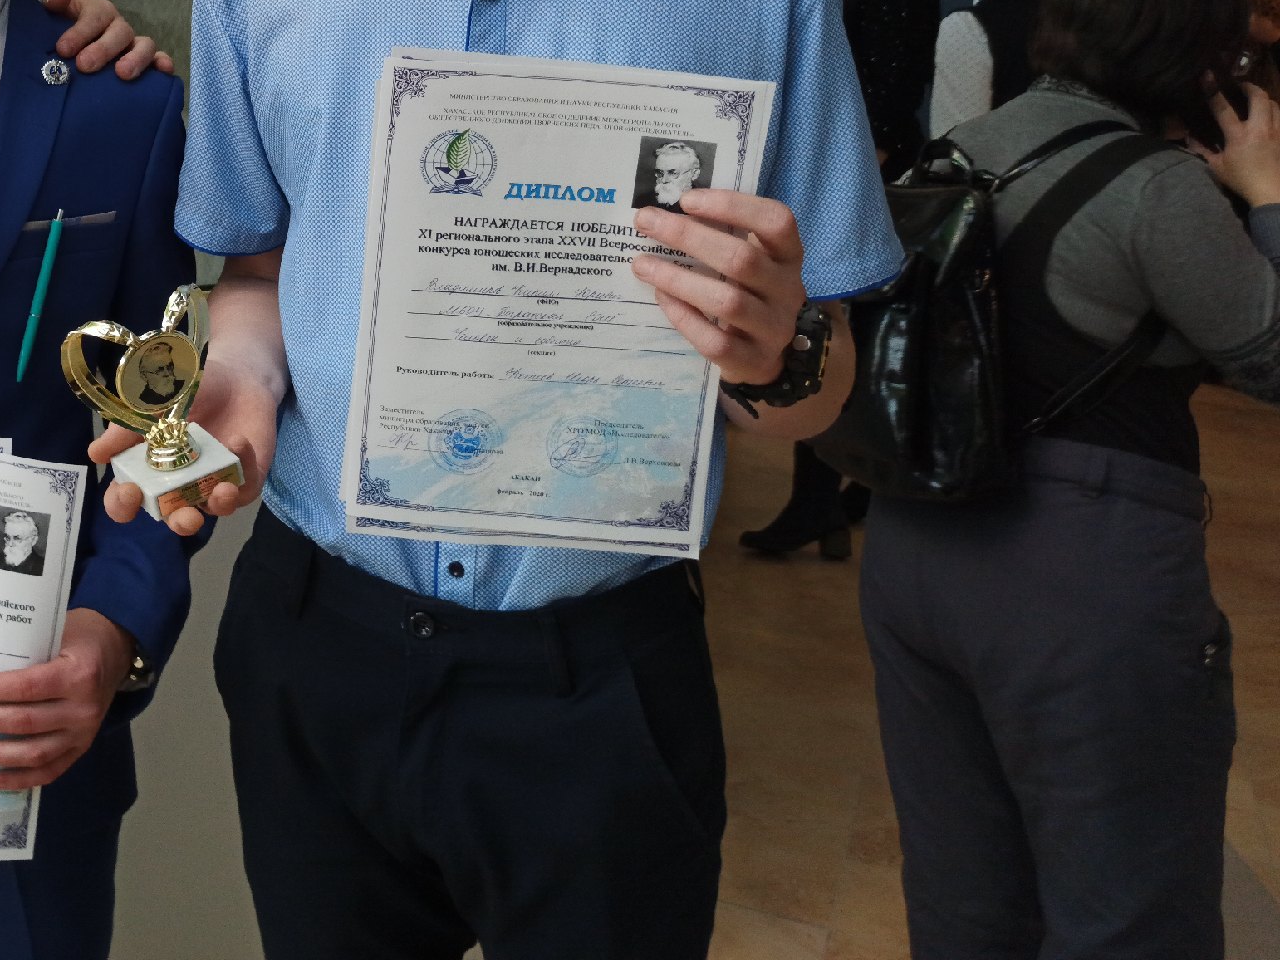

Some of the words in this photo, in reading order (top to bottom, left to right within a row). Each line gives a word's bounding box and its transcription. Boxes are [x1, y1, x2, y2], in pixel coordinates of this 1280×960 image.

[503, 182, 617, 204] ДИПЛОМ
[454, 216, 564, 231] НАГРАЖДАЕТСЯ
[435, 231, 521, 244] регионального
[523, 236, 554, 246] этапа
[418, 245, 471, 258] конкурса
[473, 248, 541, 260] юношеских
[491, 263, 510, 273] им.
[396, 365, 459, 377] Руководитель
[5, 612, 33, 625] работ
